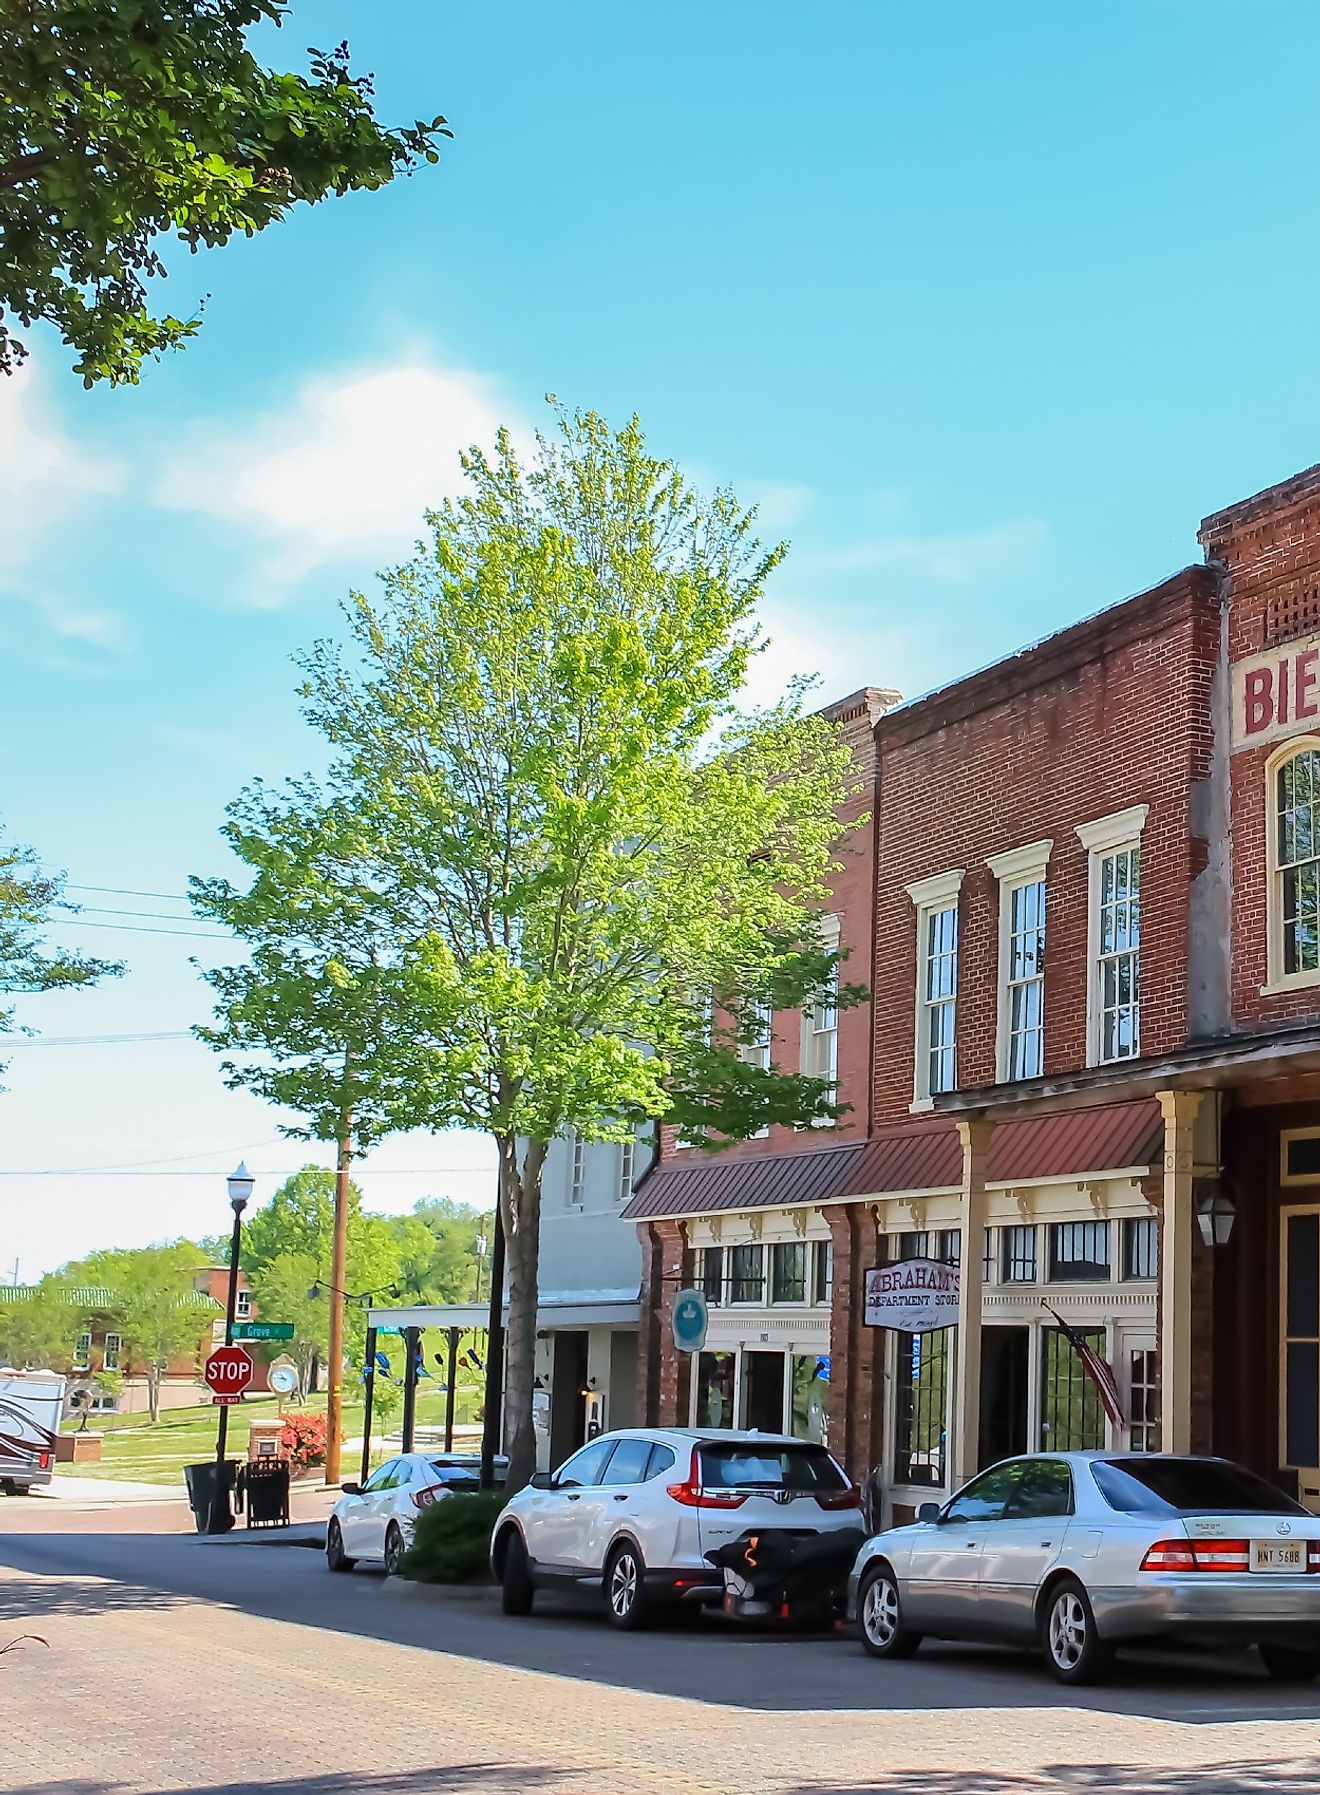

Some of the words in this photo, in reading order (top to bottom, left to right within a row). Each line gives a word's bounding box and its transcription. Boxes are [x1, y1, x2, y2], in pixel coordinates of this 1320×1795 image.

[869, 1265, 960, 1293] ABRAHAM'S
[868, 1295, 930, 1308] DEPARTMENT
[207, 1361, 250, 1380] STOP
